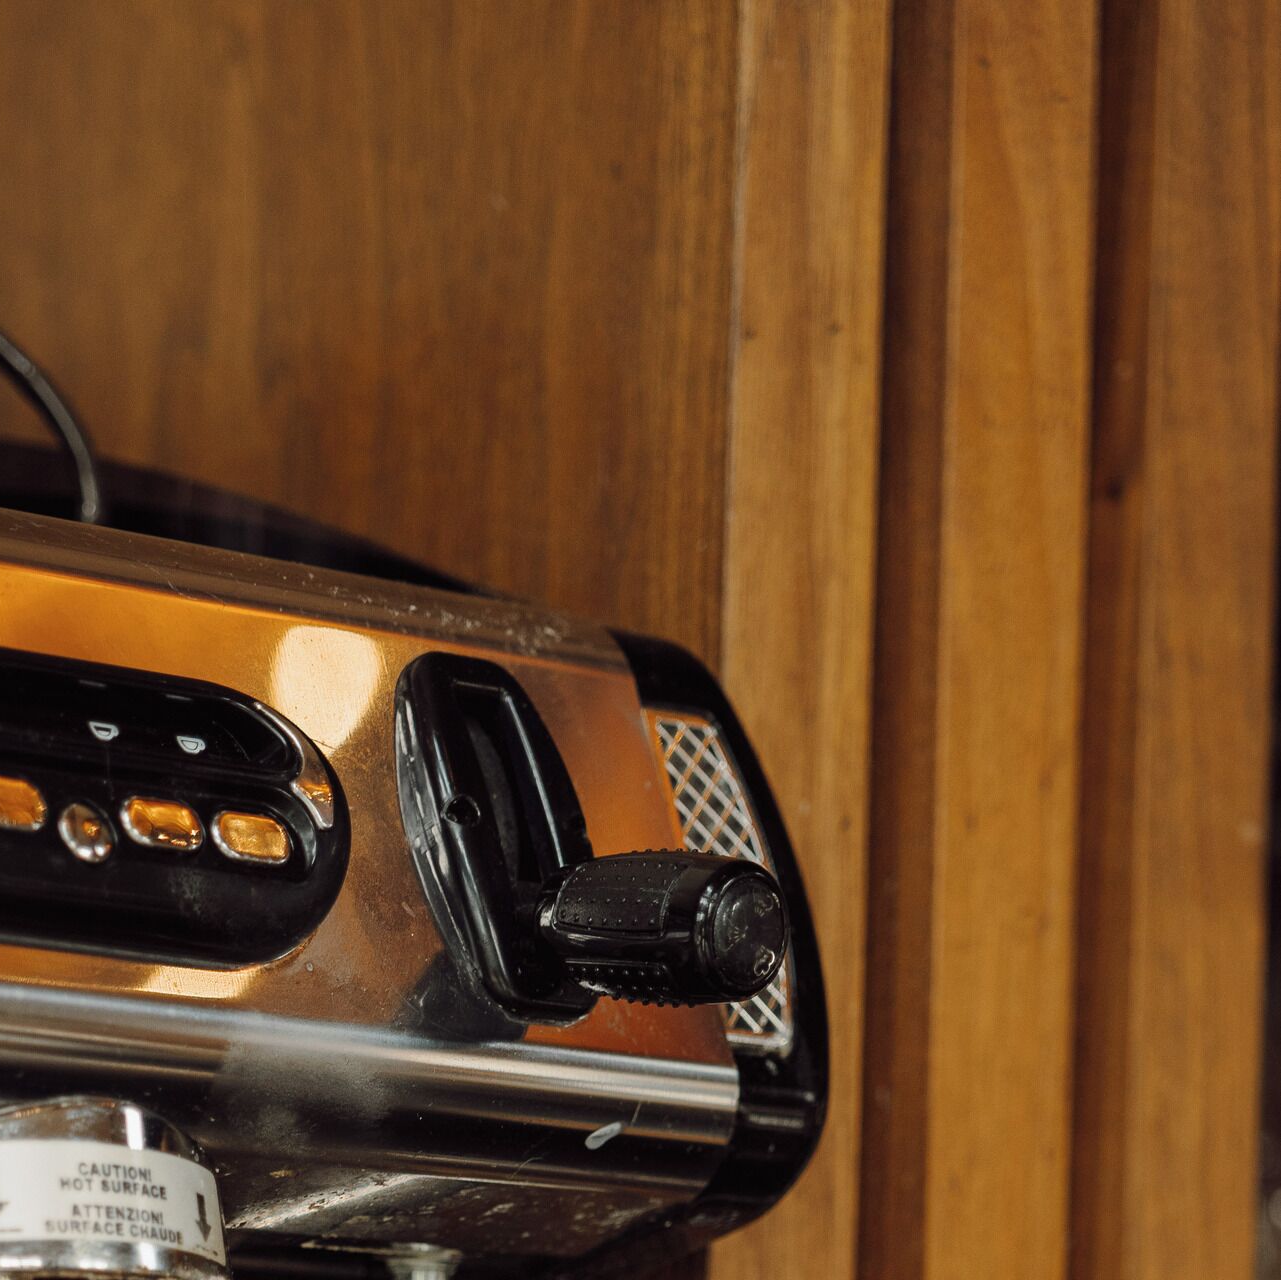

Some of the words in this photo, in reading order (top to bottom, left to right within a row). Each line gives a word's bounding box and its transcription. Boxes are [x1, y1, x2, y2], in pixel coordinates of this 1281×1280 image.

[78, 1162, 152, 1182] CAUTION!
[60, 1178, 93, 1191] HOT
[101, 1180, 167, 1200] SURFACE
[45, 1220, 123, 1237] SURFACE
[130, 1224, 183, 1244] CHAUDE
